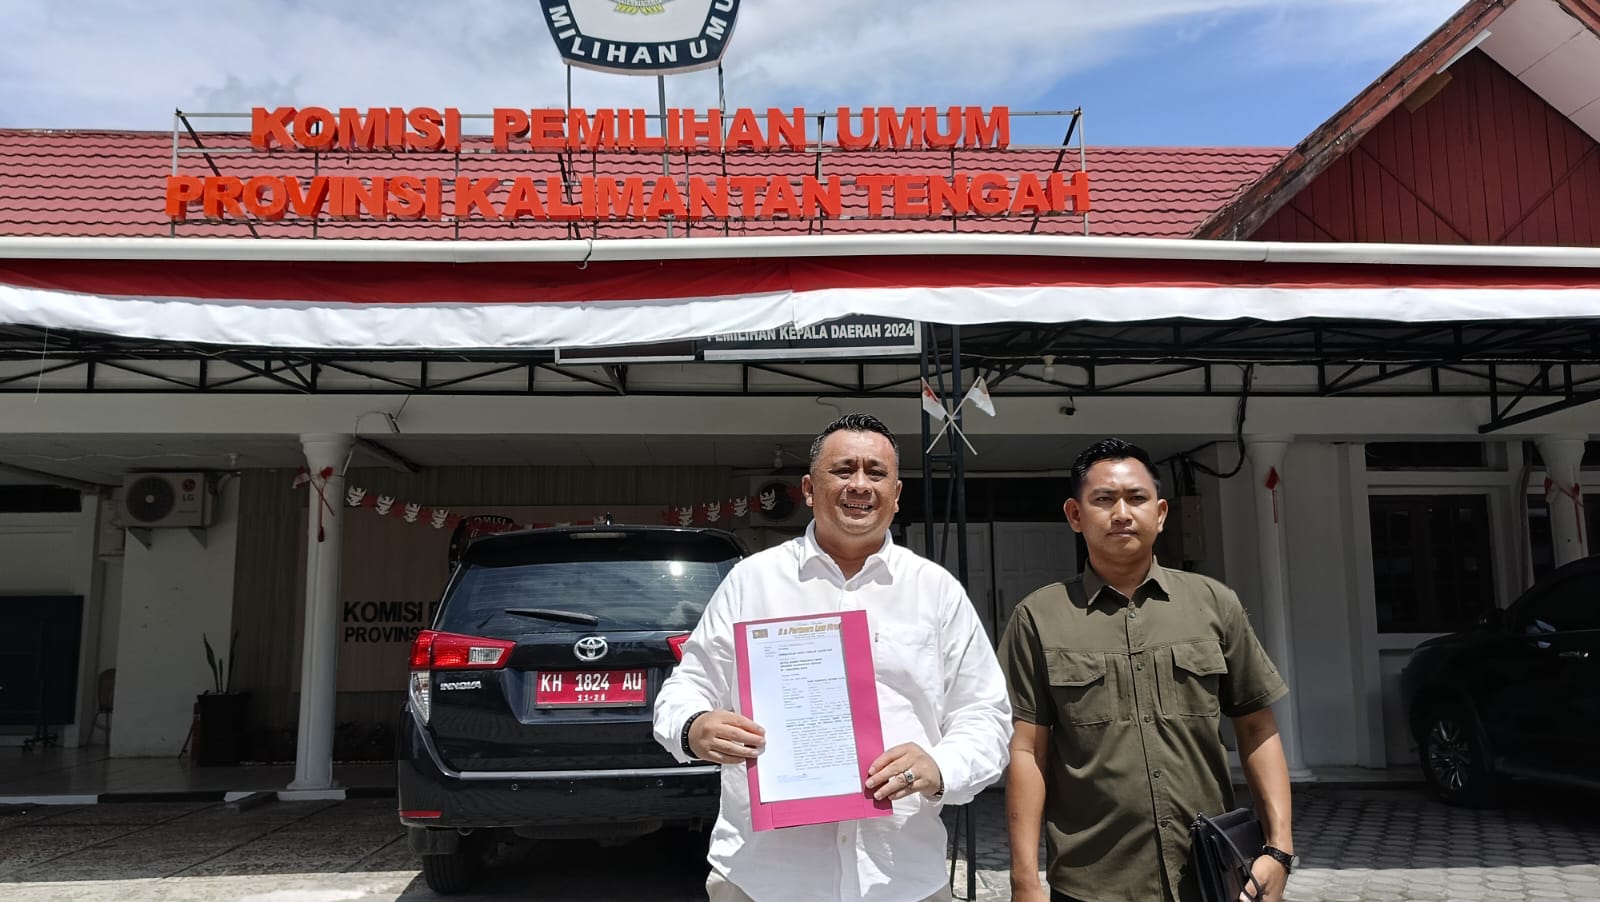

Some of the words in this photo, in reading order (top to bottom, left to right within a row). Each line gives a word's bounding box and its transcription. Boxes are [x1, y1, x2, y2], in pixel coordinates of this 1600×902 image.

[549, 5, 677, 64] MILIHAN
[689, 0, 736, 59] UMU
[251, 106, 461, 153] KOMISI
[493, 107, 806, 153] PEMILIHAN
[837, 105, 1010, 152] UMUM
[165, 174, 442, 222] PROVINSI
[454, 175, 841, 222] KALIMANTAN
[855, 171, 1091, 218] TENGAH
[779, 325, 827, 340] KEPALA
[830, 323, 882, 339] DAERAH
[884, 322, 915, 338] 2024
[343, 601, 424, 623] KOMISI
[344, 626, 425, 643] PROVINS
[439, 680, 482, 691] INNOVA
[540, 673, 563, 692] KH
[574, 672, 610, 692] 1824
[622, 672, 643, 691] AU
